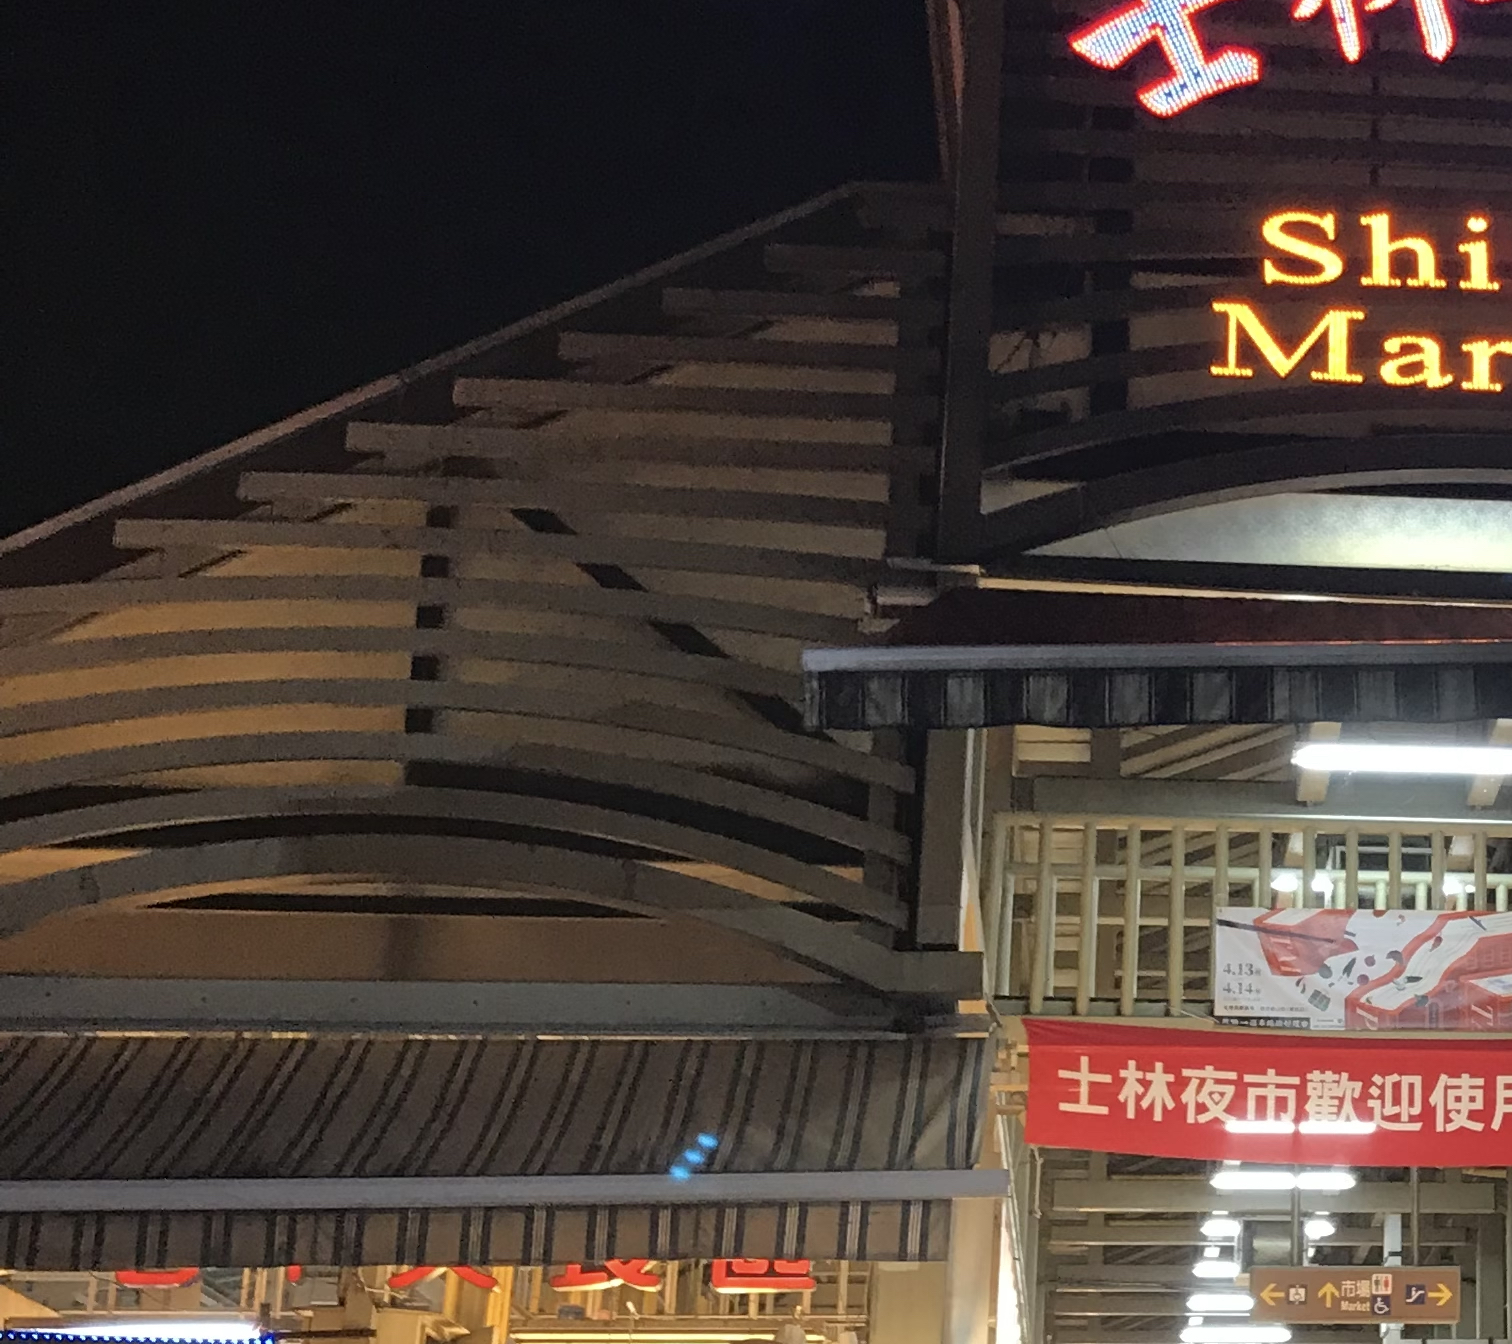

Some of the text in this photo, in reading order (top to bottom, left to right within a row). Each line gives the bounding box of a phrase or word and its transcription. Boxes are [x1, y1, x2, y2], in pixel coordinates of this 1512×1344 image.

[1222, 962, 1254, 976] 4.13
[1222, 981, 1253, 995] 4.14
[1340, 1279, 1371, 1298] 市場
[1340, 1300, 1371, 1312] Market
